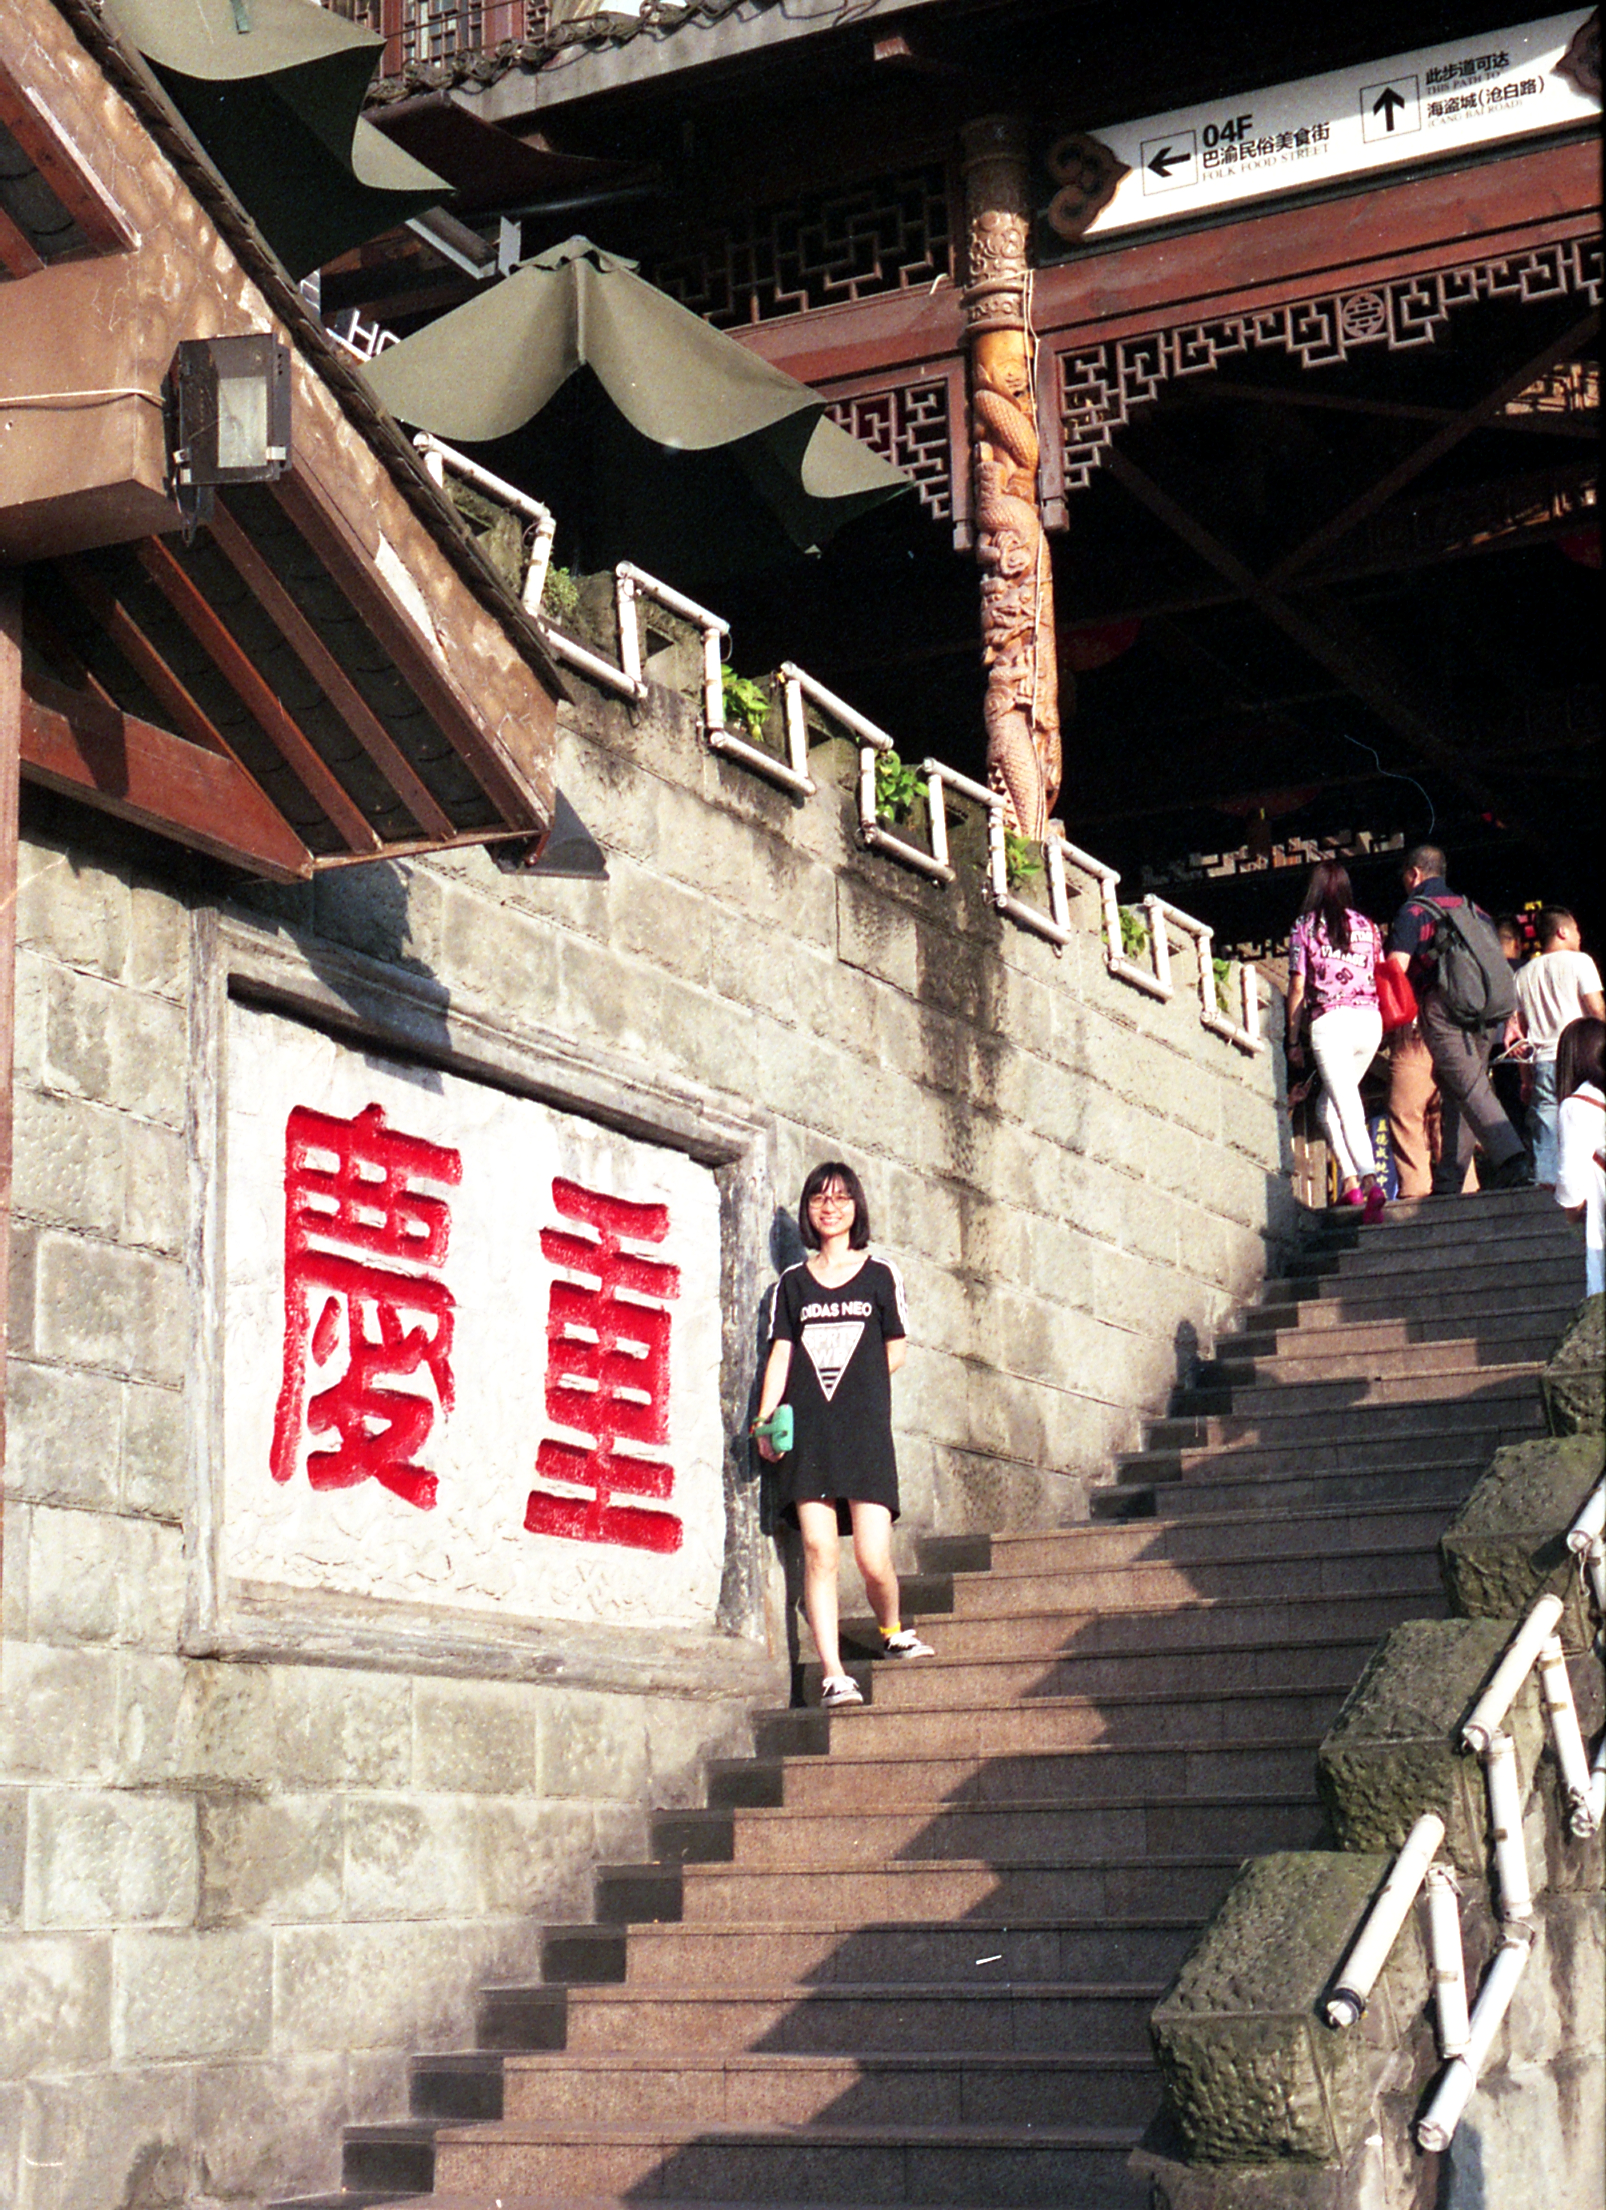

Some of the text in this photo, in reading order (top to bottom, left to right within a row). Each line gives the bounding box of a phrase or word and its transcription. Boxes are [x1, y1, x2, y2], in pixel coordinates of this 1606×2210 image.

[1426, 51, 1509, 85] 此步道可达
[1427, 71, 1501, 95] THIS PATH TO
[1203, 114, 1253, 148] 04F
[1203, 122, 1330, 169] 巴渝民俗美食街
[1203, 144, 1330, 182] FOLK FOOD STREET
[841, 1301, 872, 1317] NEO
